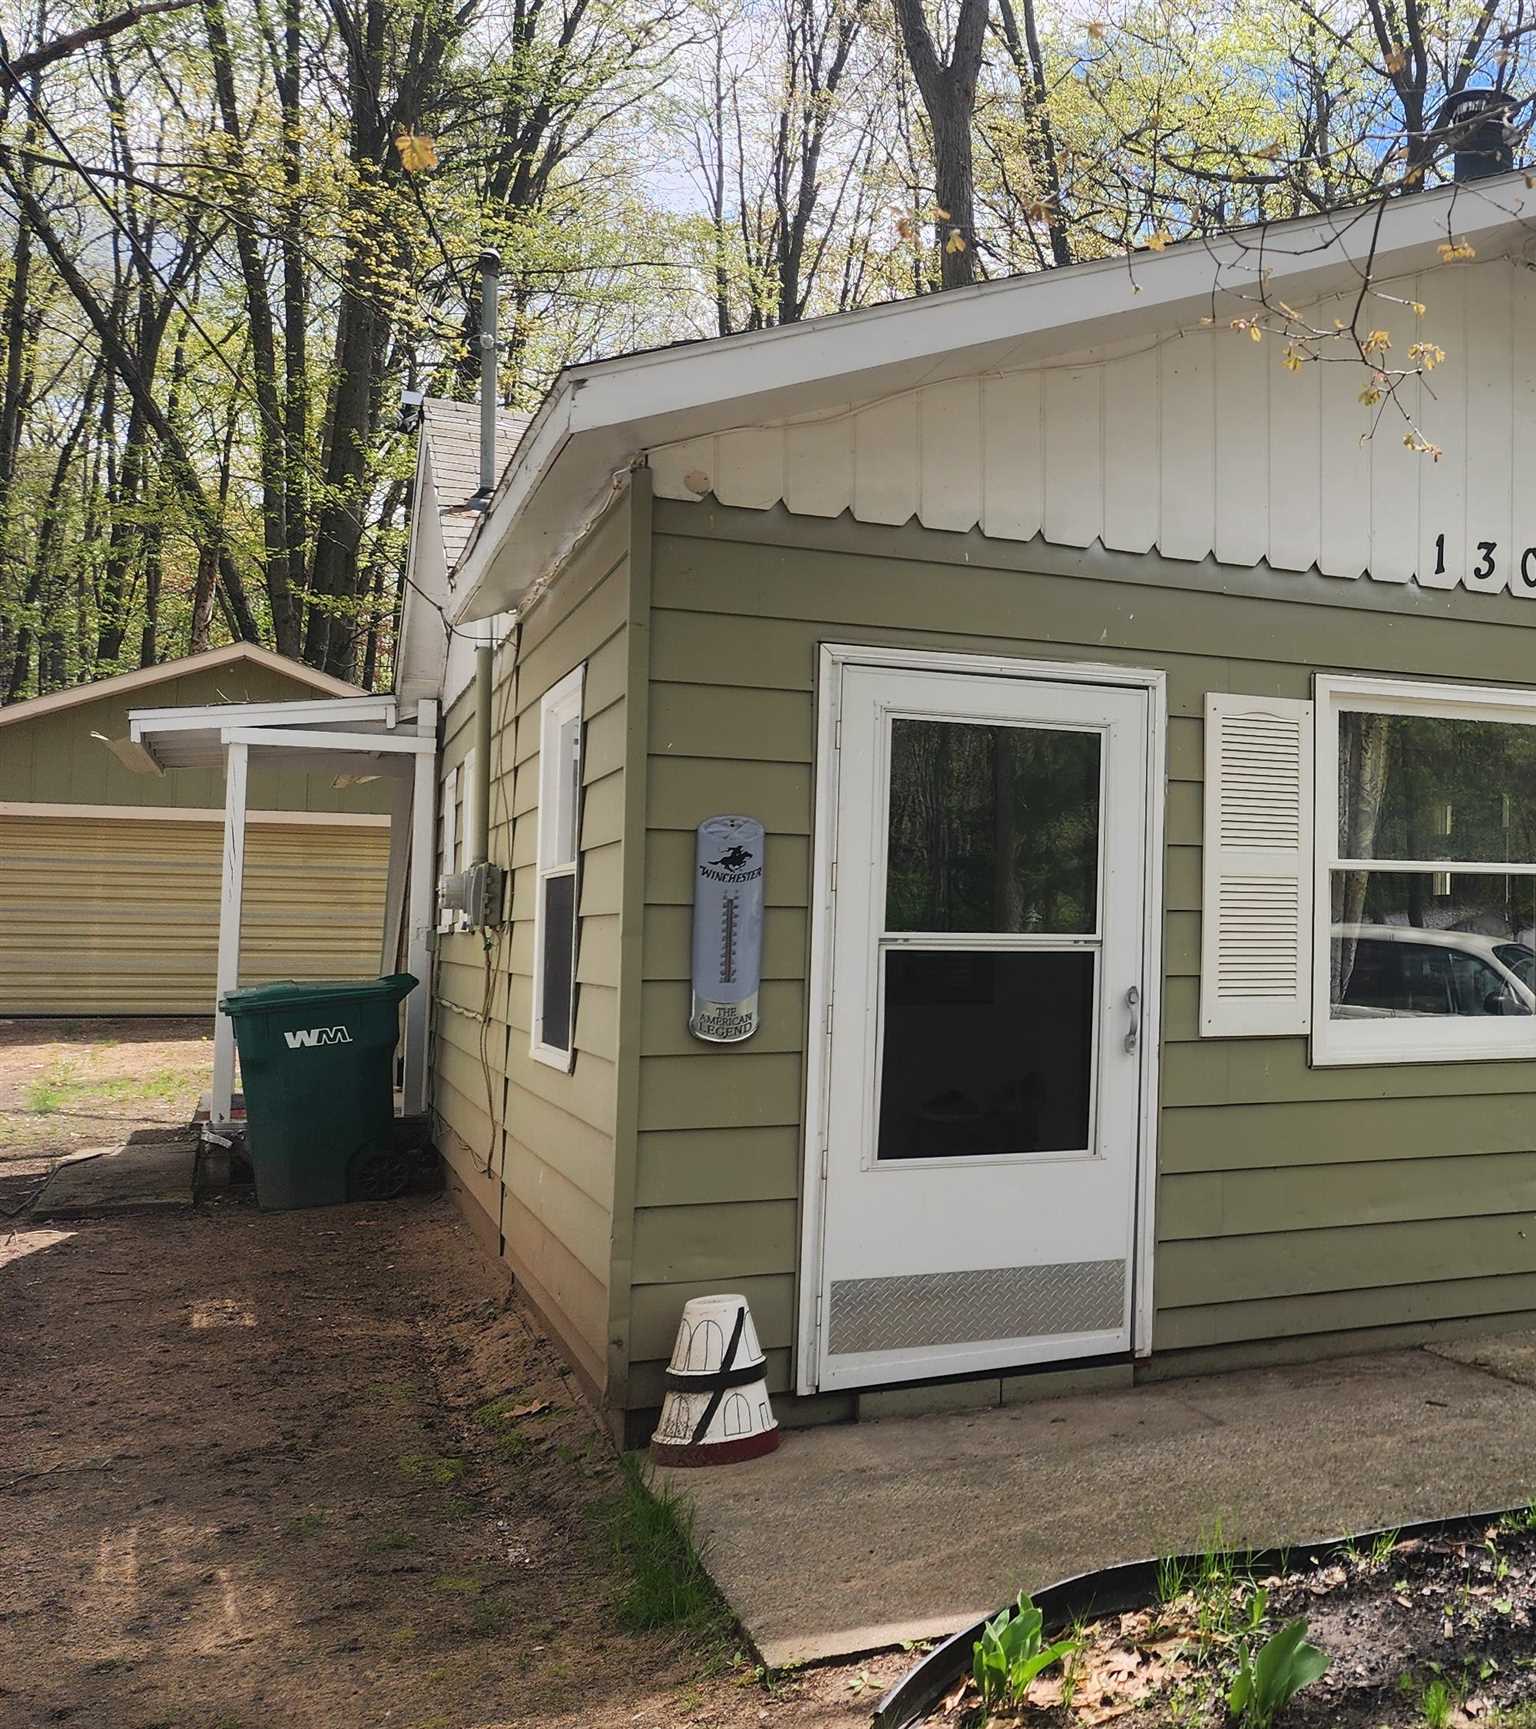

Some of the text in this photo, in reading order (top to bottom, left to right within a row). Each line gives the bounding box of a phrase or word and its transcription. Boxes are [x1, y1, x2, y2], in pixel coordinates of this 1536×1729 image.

[699, 864, 762, 884] WINCHESTER
[699, 1011, 753, 1026] AMERICAN
[715, 1007, 737, 1018] THE
[283, 1025, 353, 1049] WM
[698, 1022, 753, 1040] LEGEND
